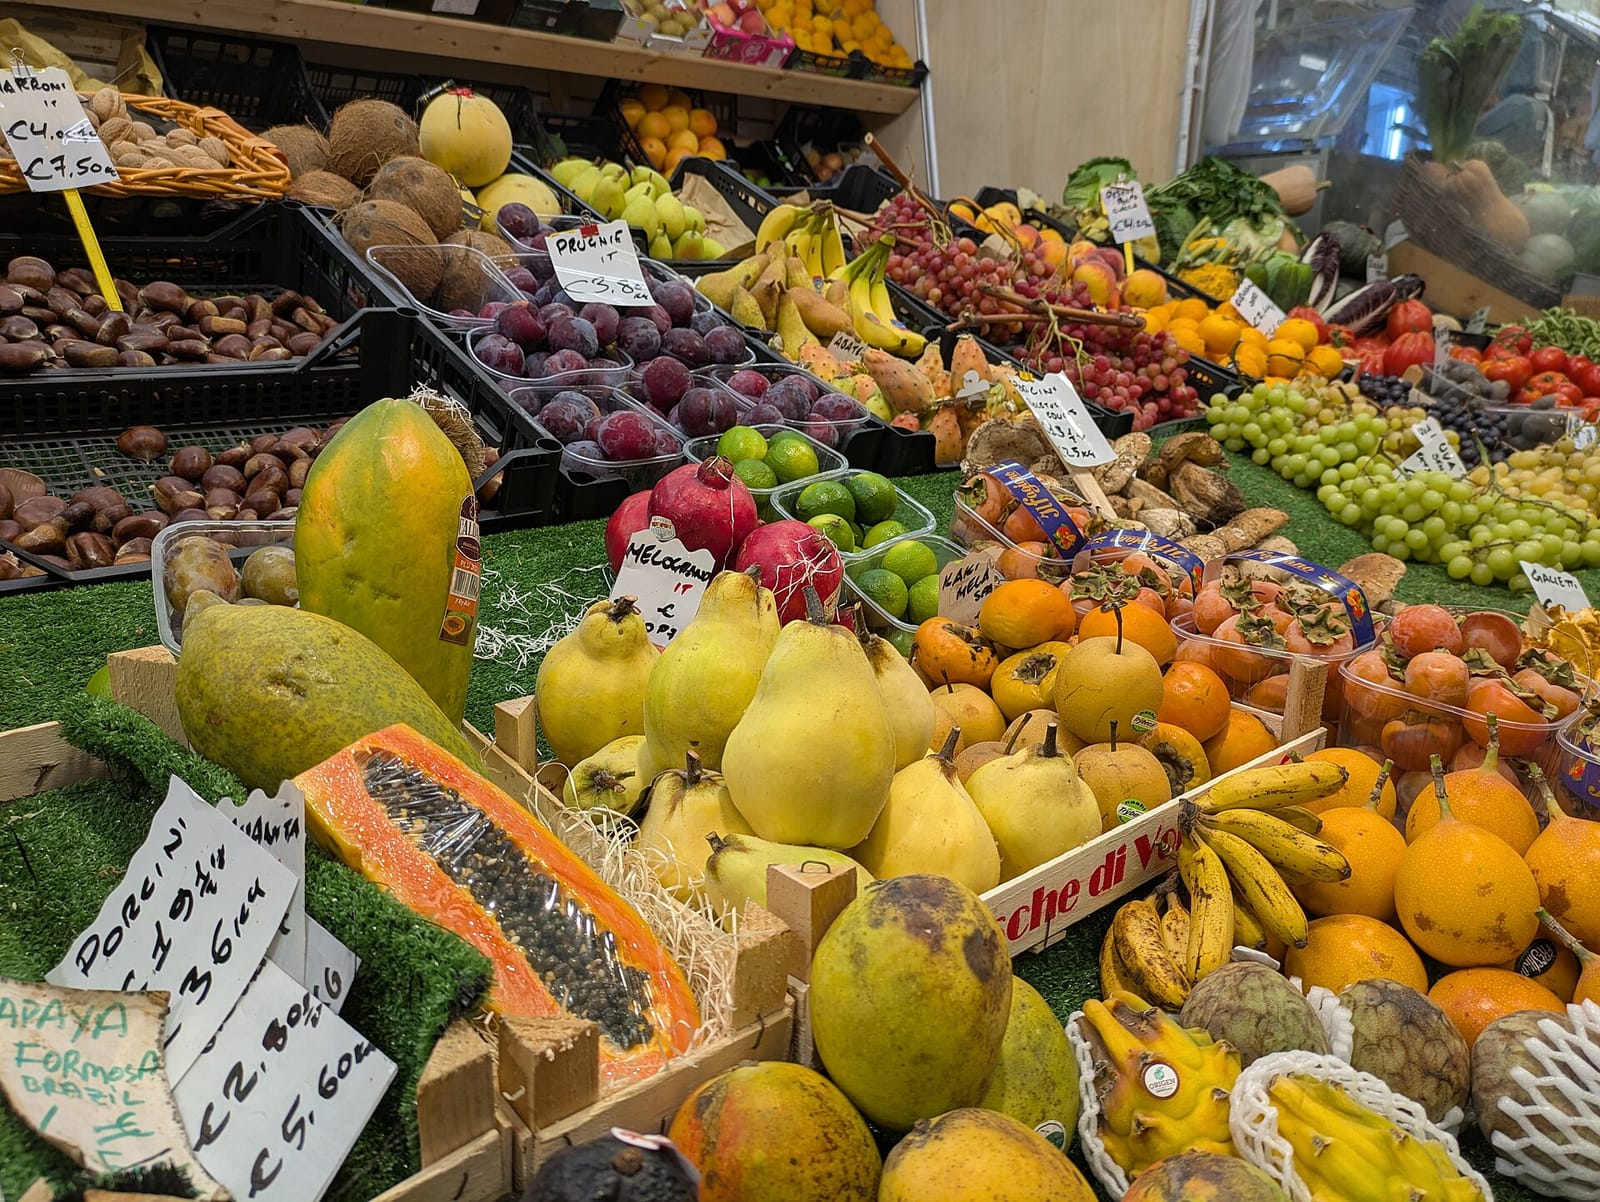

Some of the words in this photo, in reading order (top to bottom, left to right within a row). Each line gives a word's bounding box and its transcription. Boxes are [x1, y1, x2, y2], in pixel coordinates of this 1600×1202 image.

[673, 582, 694, 596] IT
[942, 562, 980, 591] KAKI
[1088, 843, 1128, 897] di
[0, 997, 128, 1043] APAYA
[1149, 1077, 1176, 1090] ORIGEN
